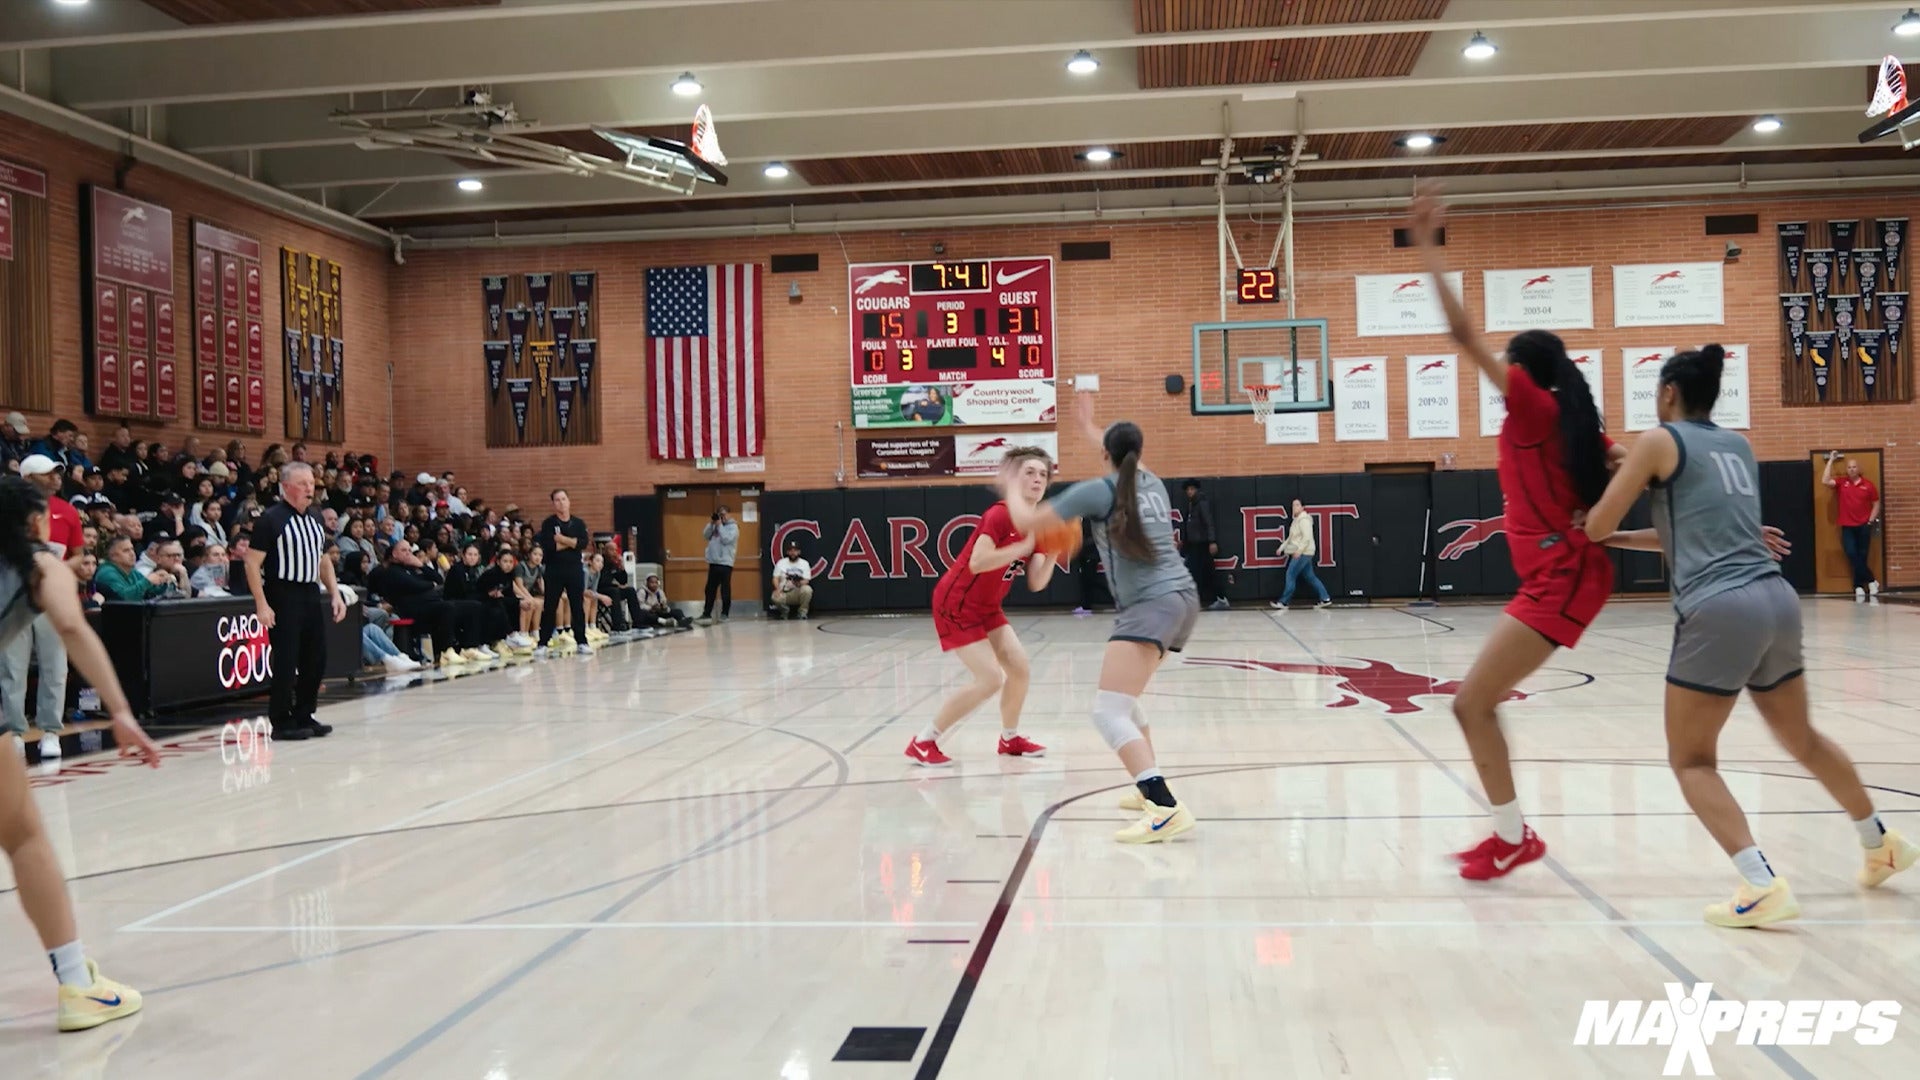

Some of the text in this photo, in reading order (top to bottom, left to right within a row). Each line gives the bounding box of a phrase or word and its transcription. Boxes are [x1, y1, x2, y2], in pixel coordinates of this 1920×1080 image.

[932, 264, 987, 288] 7:41
[1242, 272, 1274, 300] 22
[856, 296, 910, 310] COUGARS
[999, 291, 1038, 305] GUEST
[936, 300, 965, 311] PERIOD
[880, 312, 904, 338] 15
[946, 312, 958, 334] 3
[1009, 308, 1040, 333] 31
[862, 340, 887, 350] FOULS
[896, 340, 917, 349] T.O.L.
[927, 337, 979, 348] PLAYER FOUL
[988, 336, 1009, 346] T.O.L.
[1018, 335, 1043, 345] FOULS
[872, 350, 883, 371] 0
[902, 349, 913, 370] 3
[992, 347, 1004, 366] 4
[1028, 345, 1040, 366] 0
[862, 374, 887, 384] SCORE
[938, 372, 967, 381] MATCH
[1018, 369, 1045, 378] SCORE
[973, 388, 1034, 397] Countrywood
[966, 398, 1008, 406] Shopping
[1352, 400, 1370, 409] 2021
[1418, 397, 1448, 407] 2019-20
[890, 441, 921, 450] supporters
[1709, 451, 1754, 496] 10
[1138, 491, 1170, 523] 20
